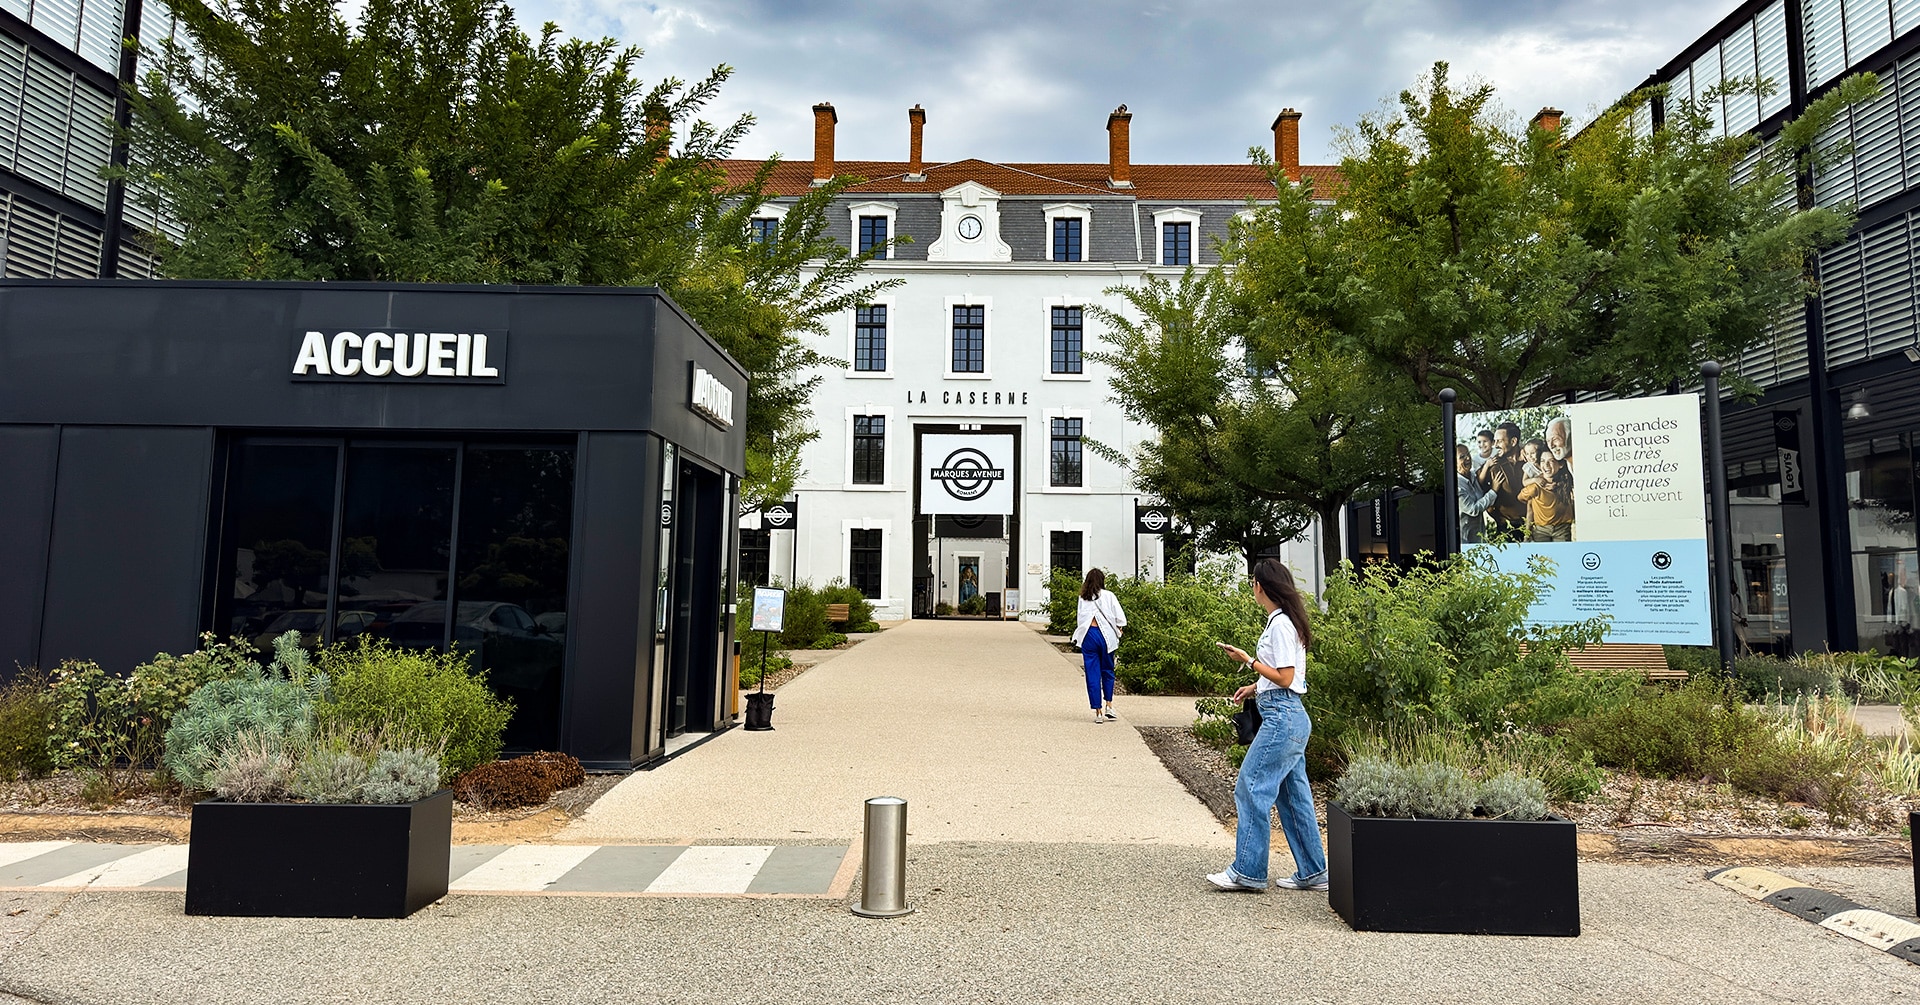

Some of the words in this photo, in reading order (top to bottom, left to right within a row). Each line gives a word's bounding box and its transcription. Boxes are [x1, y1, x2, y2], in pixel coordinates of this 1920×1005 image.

[292, 331, 499, 377] ACCUEIL
[908, 390, 927, 404] LA
[943, 391, 1028, 404] CASERNE
[1588, 422, 1614, 436] Les
[1616, 417, 1678, 436] grandes
[1604, 434, 1670, 448] marques
[1594, 452, 1608, 462] et
[1612, 448, 1631, 462] les
[1634, 446, 1662, 460] très
[932, 470, 970, 478] MARQUES
[972, 470, 1002, 478] AVENUE
[1617, 460, 1678, 478] grandes
[1589, 477, 1671, 491] démarques
[1586, 494, 1602, 505] se
[1605, 490, 1684, 504] retrouvent
[1608, 506, 1628, 518] ici.
